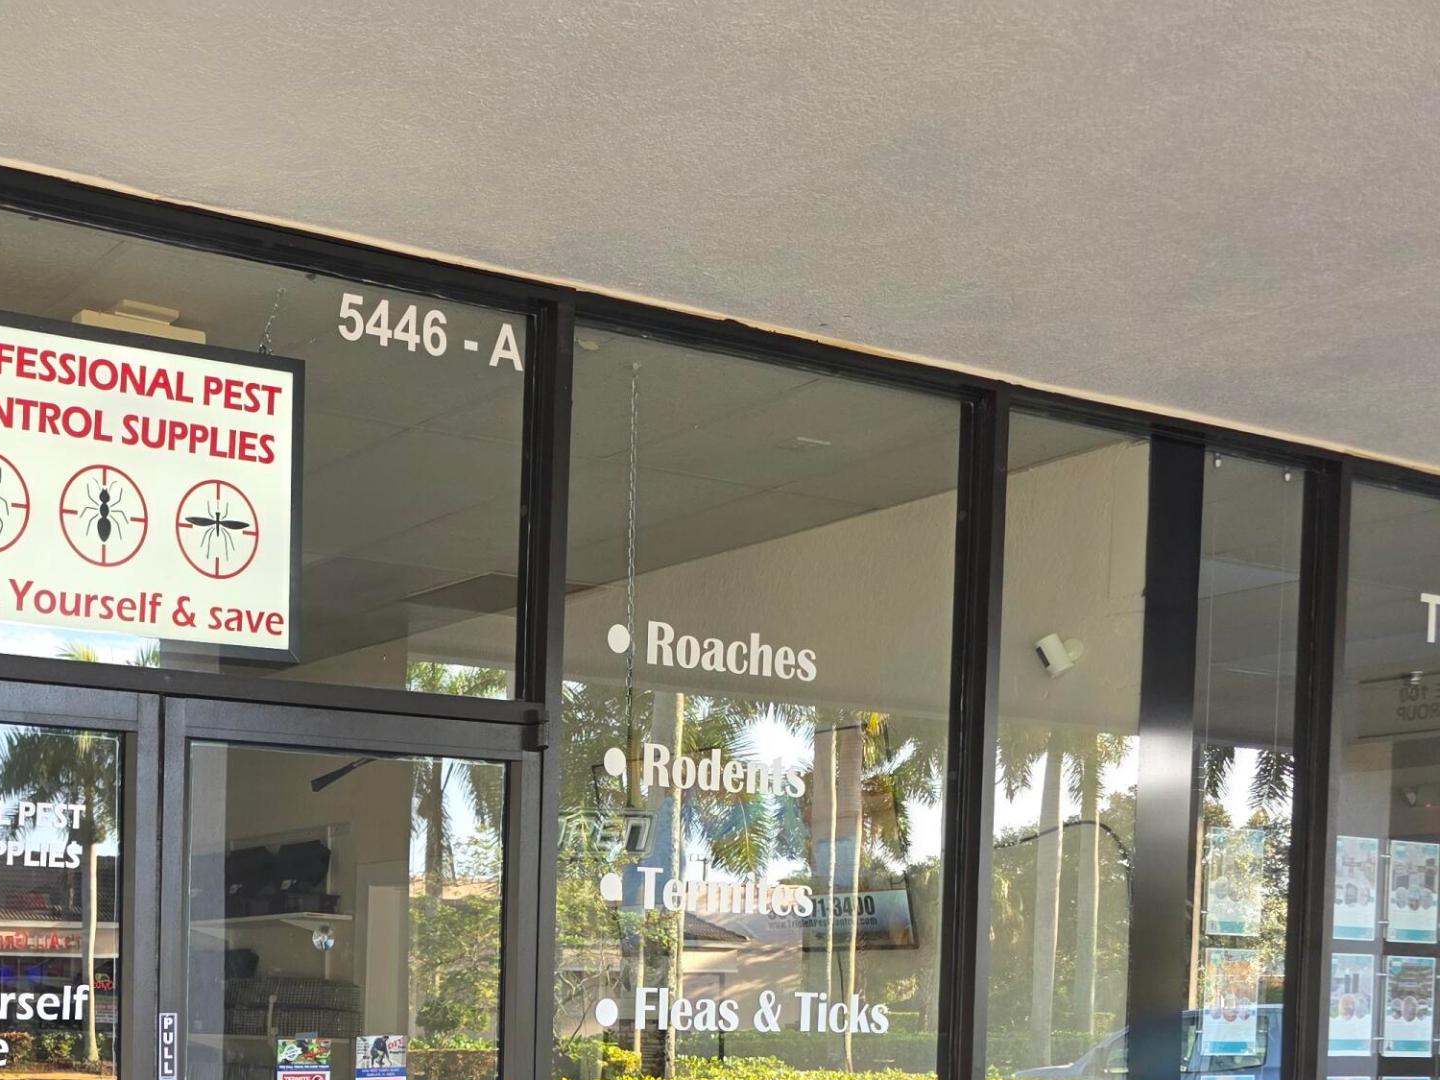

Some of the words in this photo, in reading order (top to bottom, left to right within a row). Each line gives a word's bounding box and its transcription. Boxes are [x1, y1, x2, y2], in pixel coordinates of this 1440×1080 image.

[337, 293, 448, 357] 5446
[488, 323, 523, 372] A
[203, 376, 283, 416] PEST
[122, 414, 276, 464] SUPPLIES
[8, 578, 162, 626] Yourself
[171, 594, 197, 629] &
[207, 605, 285, 637] save
[646, 620, 817, 682] Roaches
[642, 742, 806, 799] Rodents
[18, 801, 86, 830] PEST
[637, 866, 814, 917] Termites
[634, 987, 739, 1032] Fleas
[753, 990, 782, 1033] &
[794, 991, 890, 1034] Ticks
[163, 1017, 173, 1074] PULL
